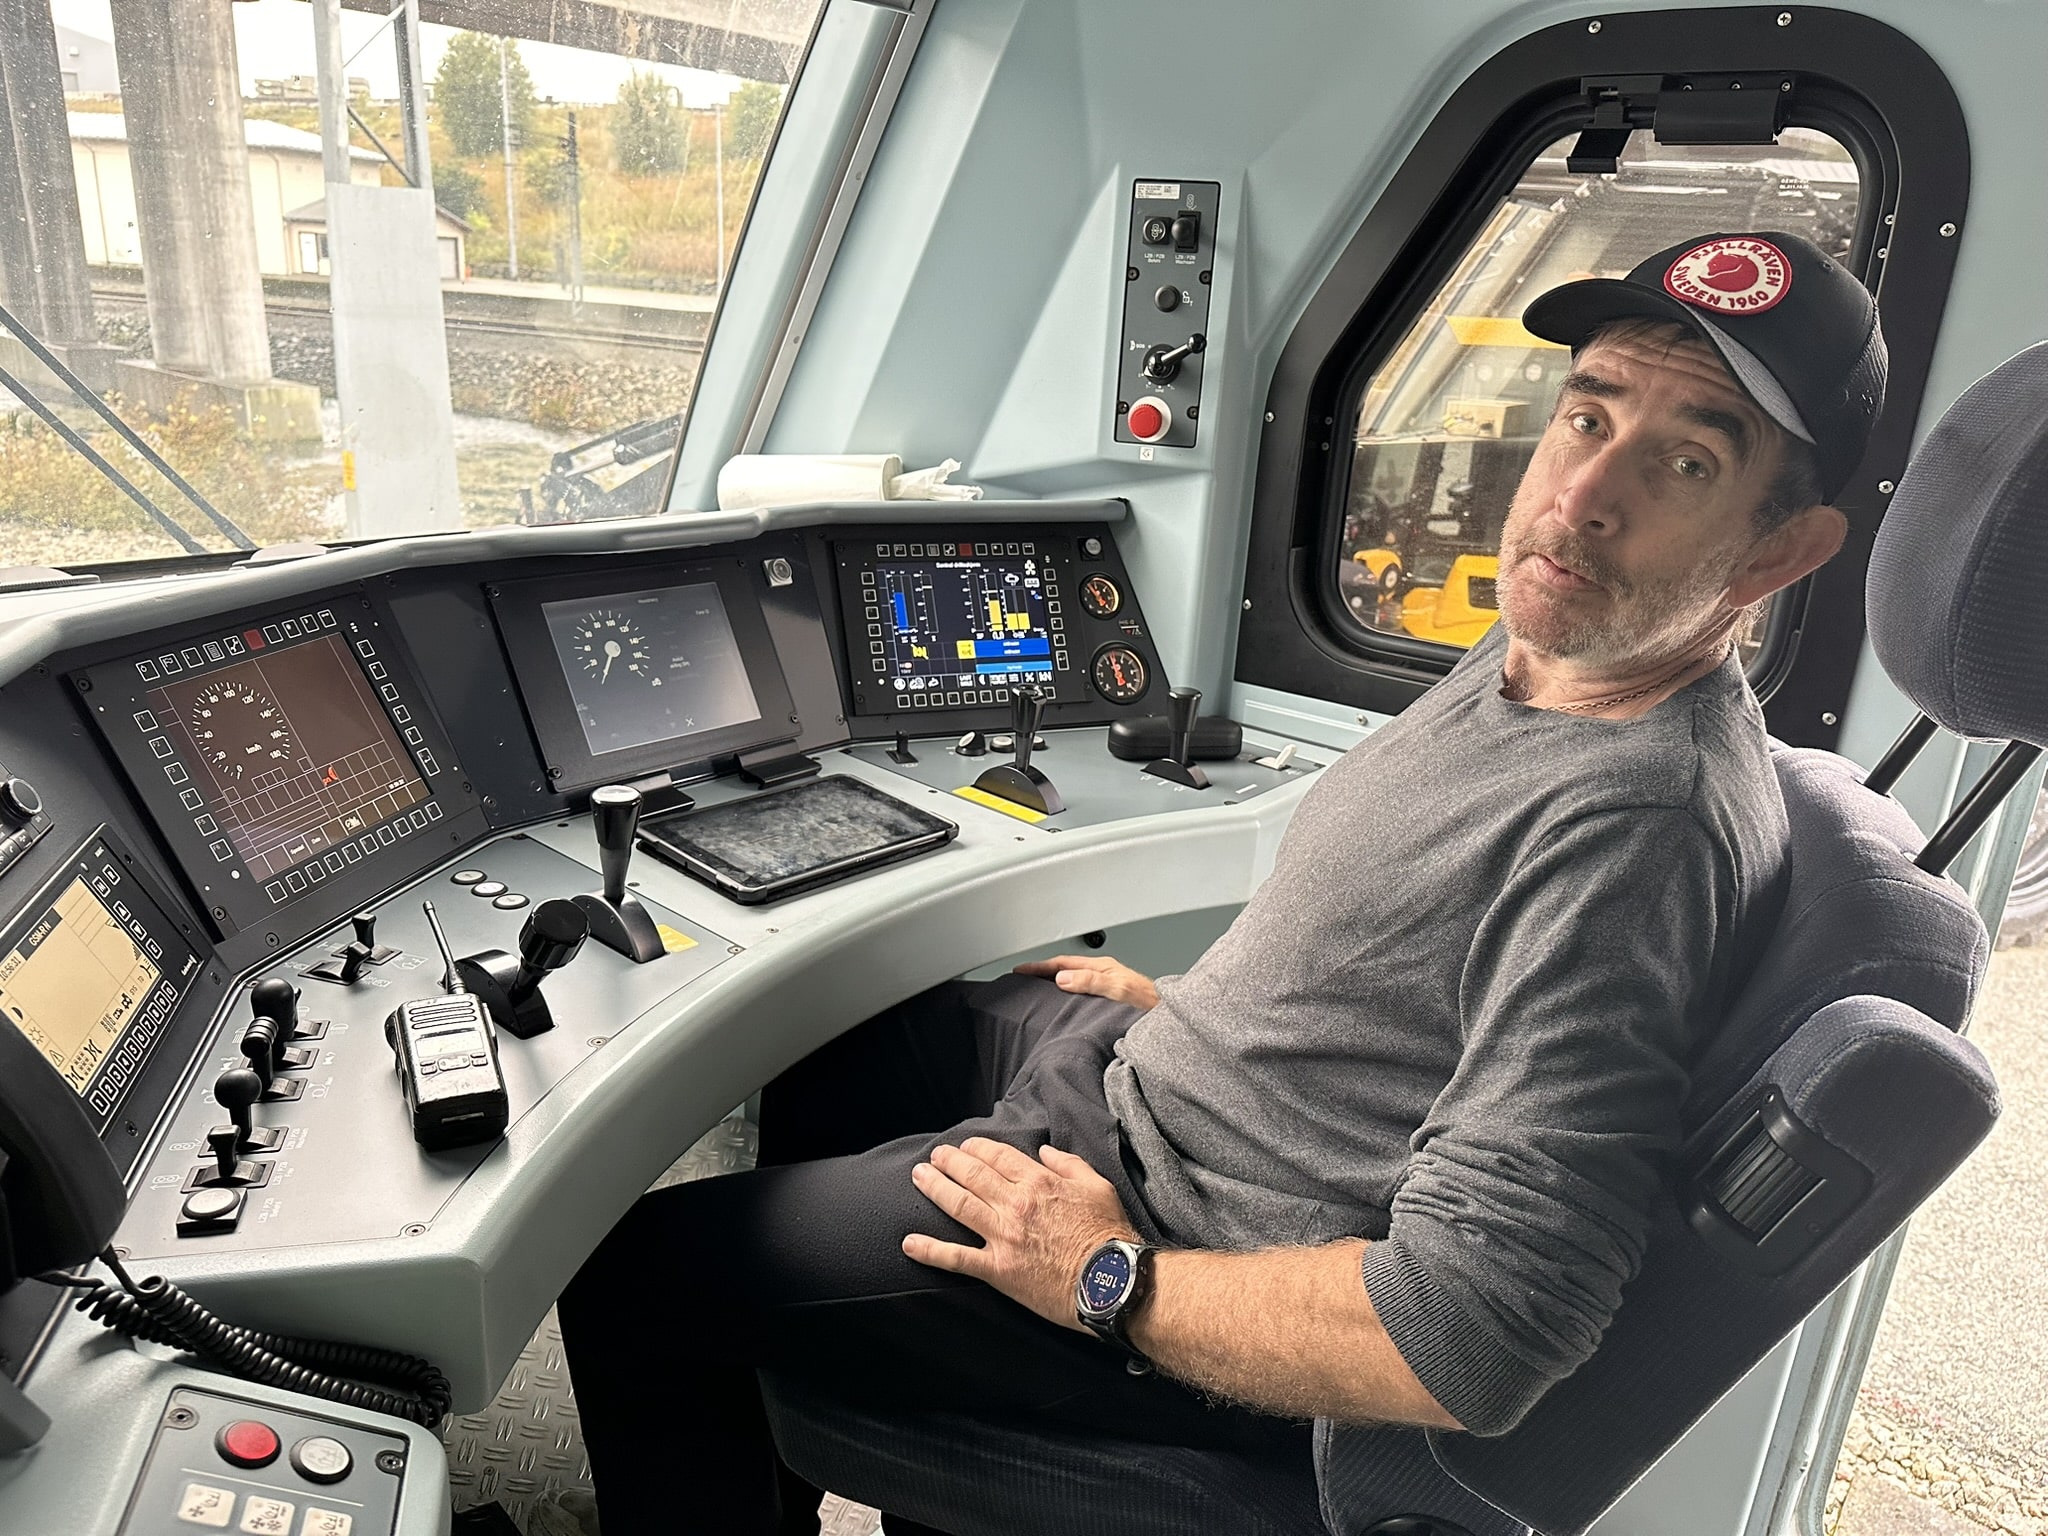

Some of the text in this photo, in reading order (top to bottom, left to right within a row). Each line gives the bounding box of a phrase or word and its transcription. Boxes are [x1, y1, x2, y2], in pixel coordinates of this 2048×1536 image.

[1673, 266, 1769, 308] SWEDEN 1960
[223, 689, 236, 698] 100
[209, 694, 218, 704] 80
[242, 695, 254, 704] 120
[202, 709, 212, 718] 60
[260, 709, 272, 719] 140
[204, 730, 214, 739] 40
[270, 730, 282, 740] 160
[216, 750, 226, 760] 20
[270, 749, 282, 760] 180
[236, 764, 243, 773] 0
